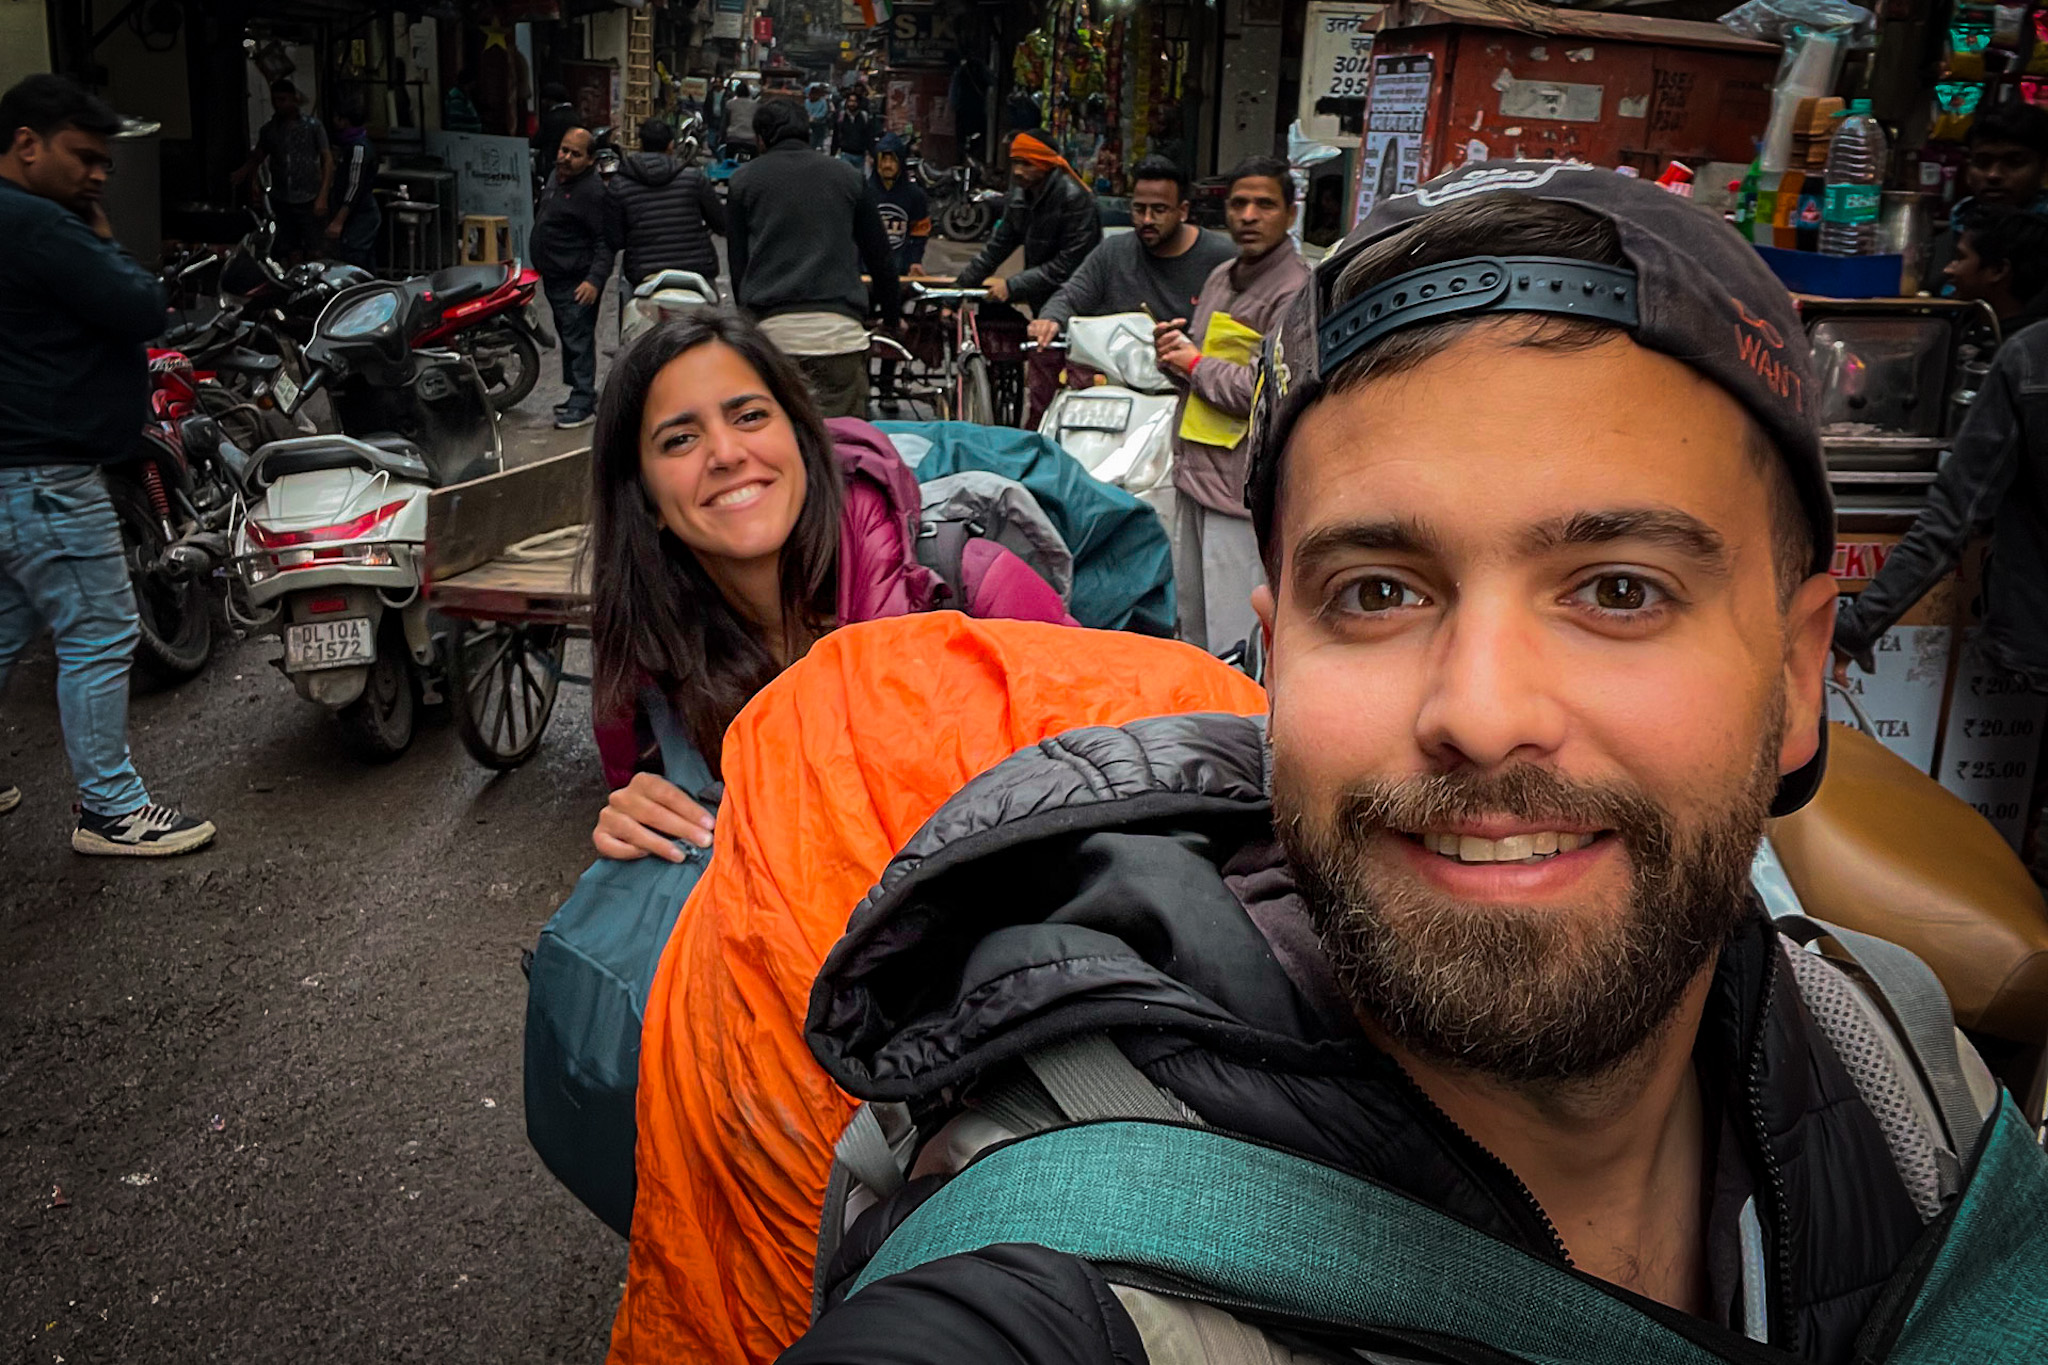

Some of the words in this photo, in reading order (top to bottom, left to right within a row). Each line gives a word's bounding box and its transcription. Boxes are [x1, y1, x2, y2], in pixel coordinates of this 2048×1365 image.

[1330, 77, 1368, 93] 295
[1830, 543, 1896, 579] CKY
[1879, 634, 1901, 652] EA
[1875, 720, 1910, 738] TEA
